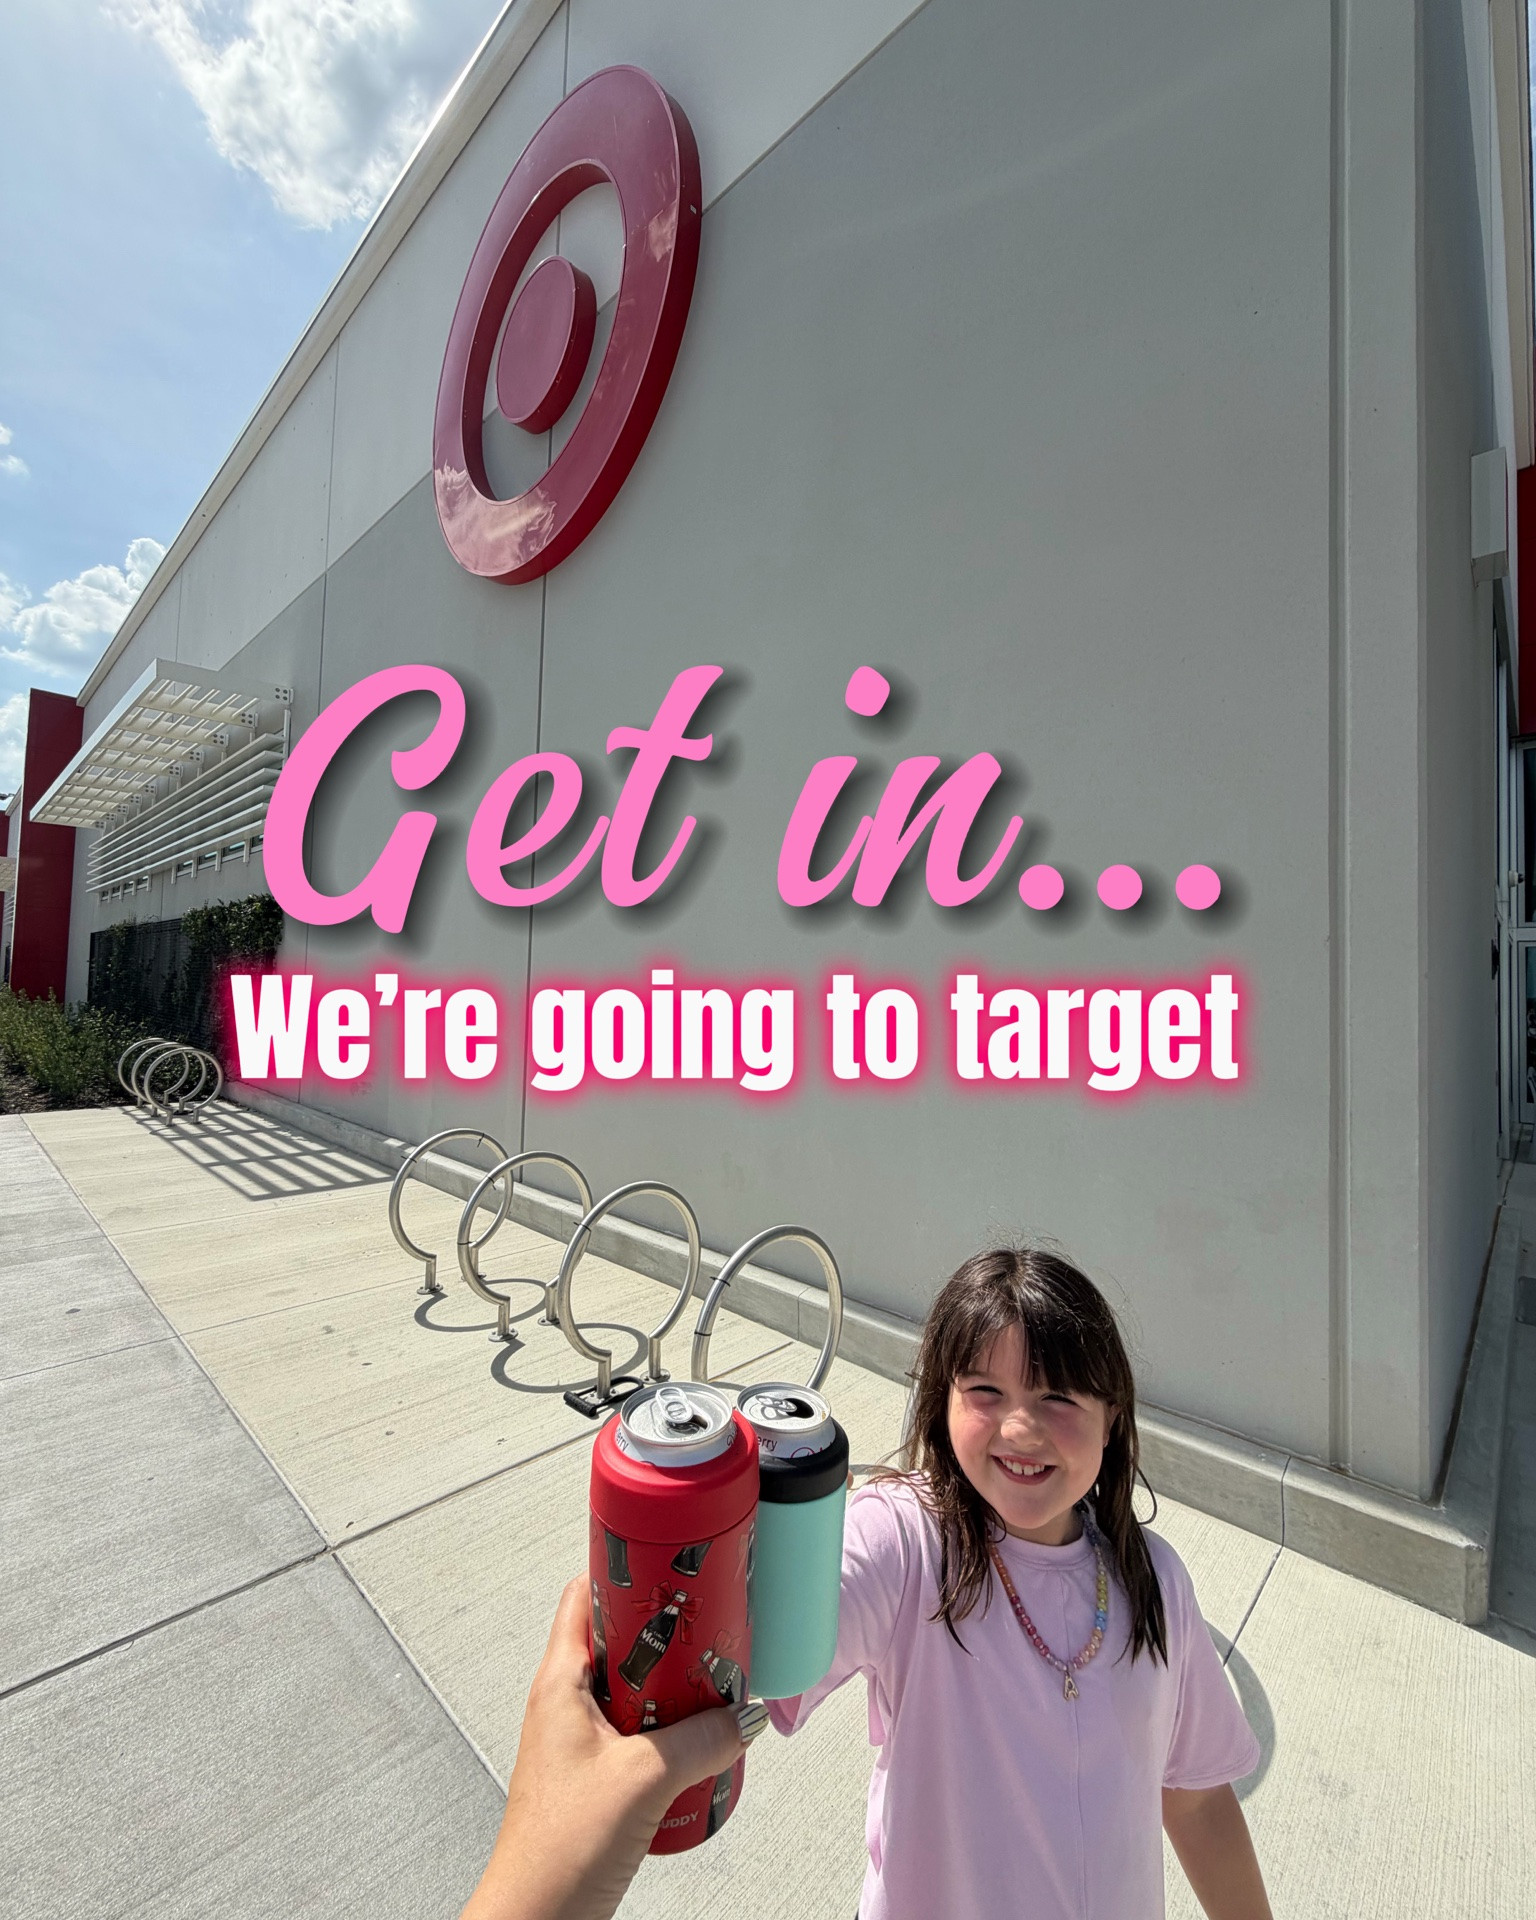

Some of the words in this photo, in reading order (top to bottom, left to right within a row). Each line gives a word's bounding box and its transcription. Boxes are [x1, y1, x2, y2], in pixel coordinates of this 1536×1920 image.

[756, 1435, 778, 1452] erry
[640, 1628, 667, 1653] Mom
[719, 1663, 739, 1695] Mom
[712, 1787, 731, 1806] Mom
[659, 1810, 699, 1829] UDDY
